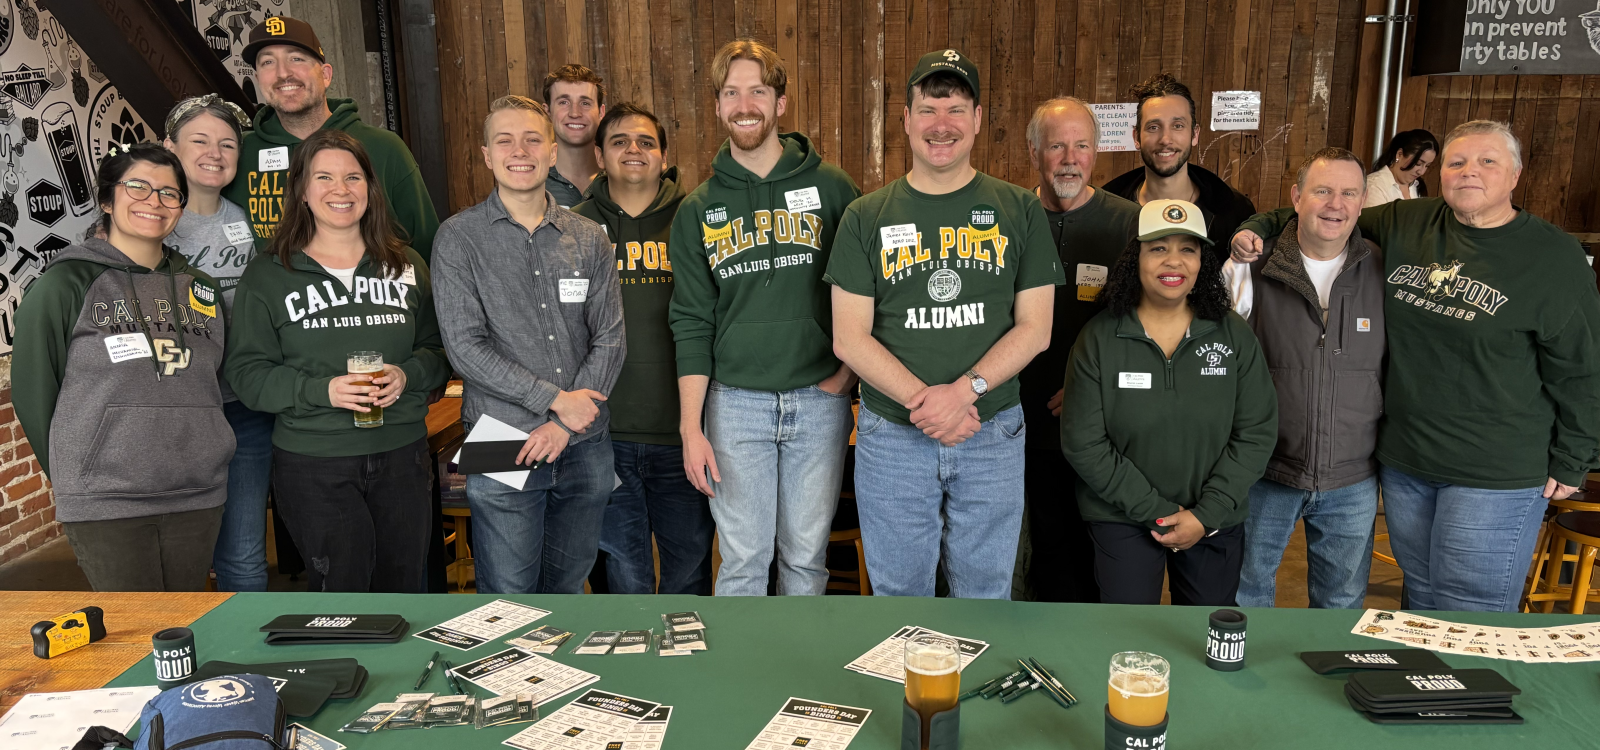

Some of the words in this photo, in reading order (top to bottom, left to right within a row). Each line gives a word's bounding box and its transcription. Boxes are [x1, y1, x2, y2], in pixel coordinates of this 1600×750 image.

[265, 16, 286, 36] SD
[1464, 22, 1484, 36] an
[1487, 17, 1567, 42] prevent
[206, 35, 229, 51] STOUP
[1464, 42, 1494, 65] rty
[1496, 41, 1561, 61] tables
[4, 74, 15, 82] NO
[16, 72, 32, 81] SLEEP
[32, 70, 45, 79] TILL
[95, 93, 115, 129] STOUP
[60, 144, 76, 157] STOUP
[30, 194, 62, 213] STOUP
[706, 211, 728, 224] PROUD
[971, 214, 995, 225] PROUD
[707, 231, 730, 240] ALUMNI
[755, 209, 824, 251] POLY
[972, 231, 998, 240] ALUMNI
[38, 247, 63, 266] STO
[626, 241, 673, 272] POL
[880, 230, 931, 281] CAL
[939, 227, 1009, 268] POLY
[719, 263, 743, 279] SAN
[743, 259, 770, 273] LUIS
[773, 252, 813, 269] OBISPO
[891, 269, 912, 285] SAN
[921, 260, 948, 271] LUIS
[956, 259, 1000, 276] OBISPO
[619, 276, 637, 285] UIS
[641, 276, 673, 285] OBISP
[194, 285, 215, 302] PROUD
[561, 288, 587, 297] Jonas
[1387, 264, 1430, 289] CAL
[1448, 274, 1509, 316] POLY
[284, 280, 349, 322] CAL
[353, 276, 410, 310] POLY
[1394, 288, 1477, 321] MUSTANGS
[91, 299, 151, 327] CAL
[302, 317, 329, 330] SAN
[333, 316, 362, 328] LUIS
[366, 313, 406, 326] OBISPO
[904, 302, 985, 329] ALUMNI
[1195, 343, 1212, 357] CAL
[1212, 342, 1234, 358] POLY
[1200, 367, 1227, 376] ALUMNI
[1207, 626, 1221, 640] CAL
[1224, 630, 1247, 641] POLY
[162, 645, 191, 659] POLY
[960, 643, 975, 651] DAY
[1206, 636, 1245, 660] PROUD
[154, 656, 192, 678] ROUD
[1349, 657, 1400, 665] PROUD
[1410, 679, 1467, 691] PROUD
[586, 696, 630, 708] FOUNDERS
[627, 704, 644, 713] DAY
[599, 702, 624, 712] BINGO
[793, 705, 840, 715] FOUNDERS
[839, 711, 858, 720] DAY
[1125, 736, 1149, 748] CAL
